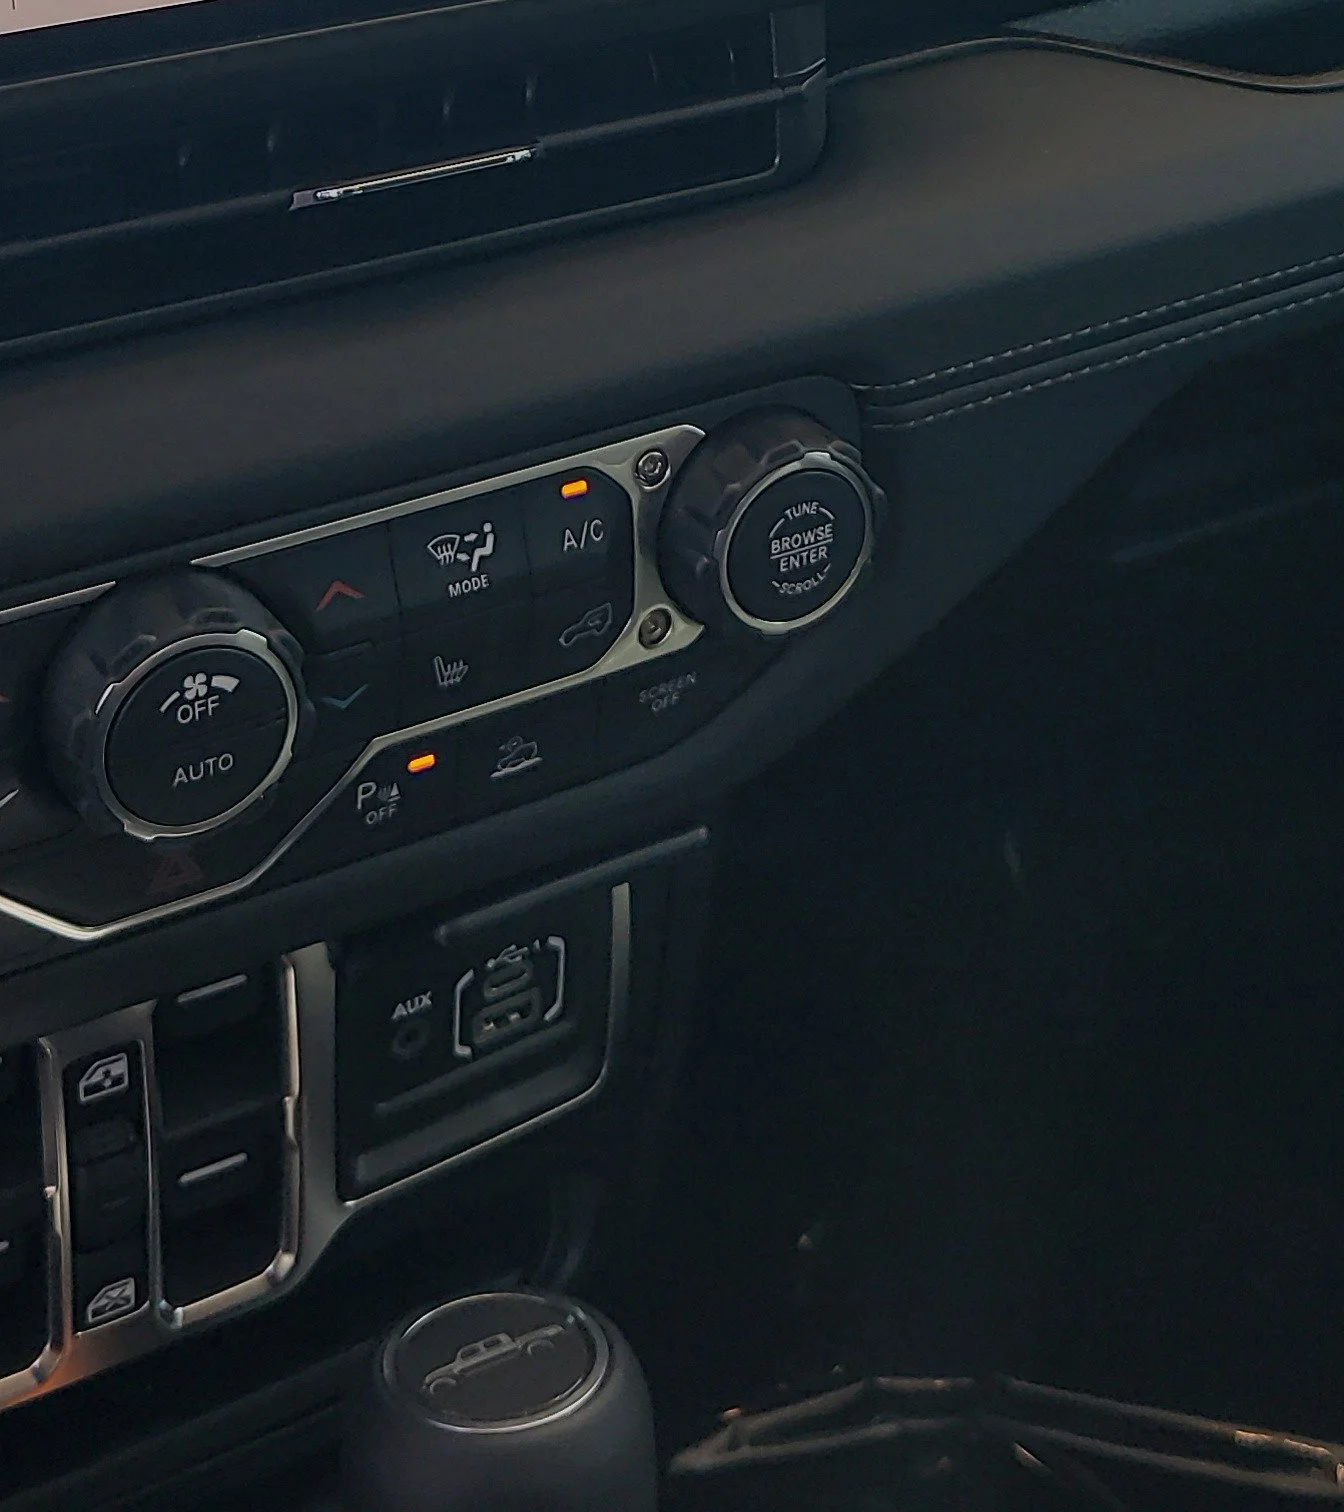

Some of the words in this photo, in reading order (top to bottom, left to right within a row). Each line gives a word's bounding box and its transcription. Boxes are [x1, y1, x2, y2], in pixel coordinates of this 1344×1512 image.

[784, 501, 819, 521] TUNE
[561, 520, 606, 554] A/C
[771, 524, 833, 554] BROWSE
[780, 546, 827, 572] ENTER
[447, 573, 490, 600] MODE
[779, 572, 827, 594] SCROLL
[177, 695, 220, 723] OFF
[171, 752, 235, 788] AUTO
[366, 803, 397, 824] OFF
[391, 991, 432, 1021] AUX
